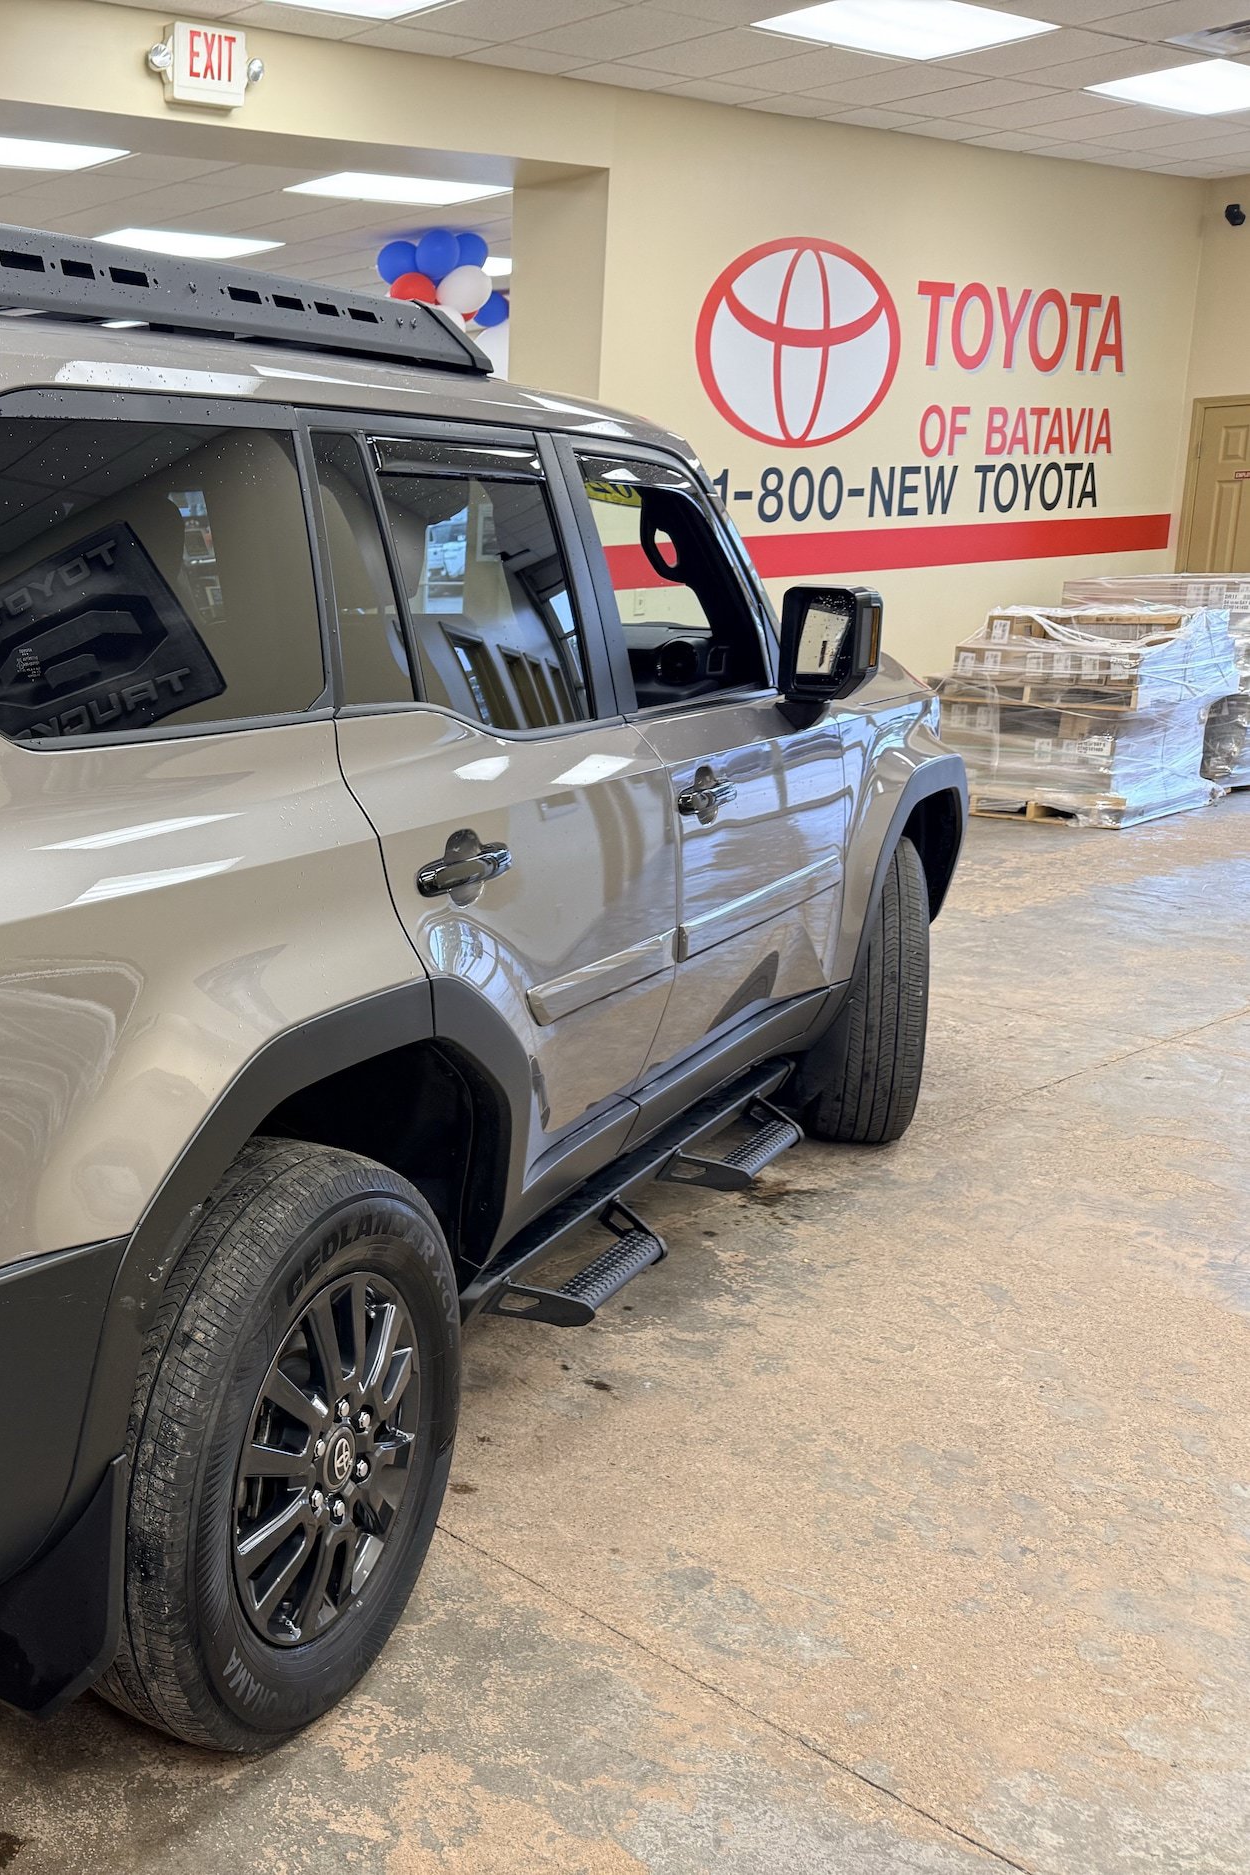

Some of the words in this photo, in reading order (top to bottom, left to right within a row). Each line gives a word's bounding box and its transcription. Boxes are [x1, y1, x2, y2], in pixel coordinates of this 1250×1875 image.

[188, 29, 237, 82] EXIT
[917, 280, 1125, 375] TOYOTA
[918, 404, 971, 457] OF
[985, 406, 1112, 457] BATAVIA
[712, 464, 959, 523] 1-800-NEW
[974, 462, 1098, 514] TOYOTA
